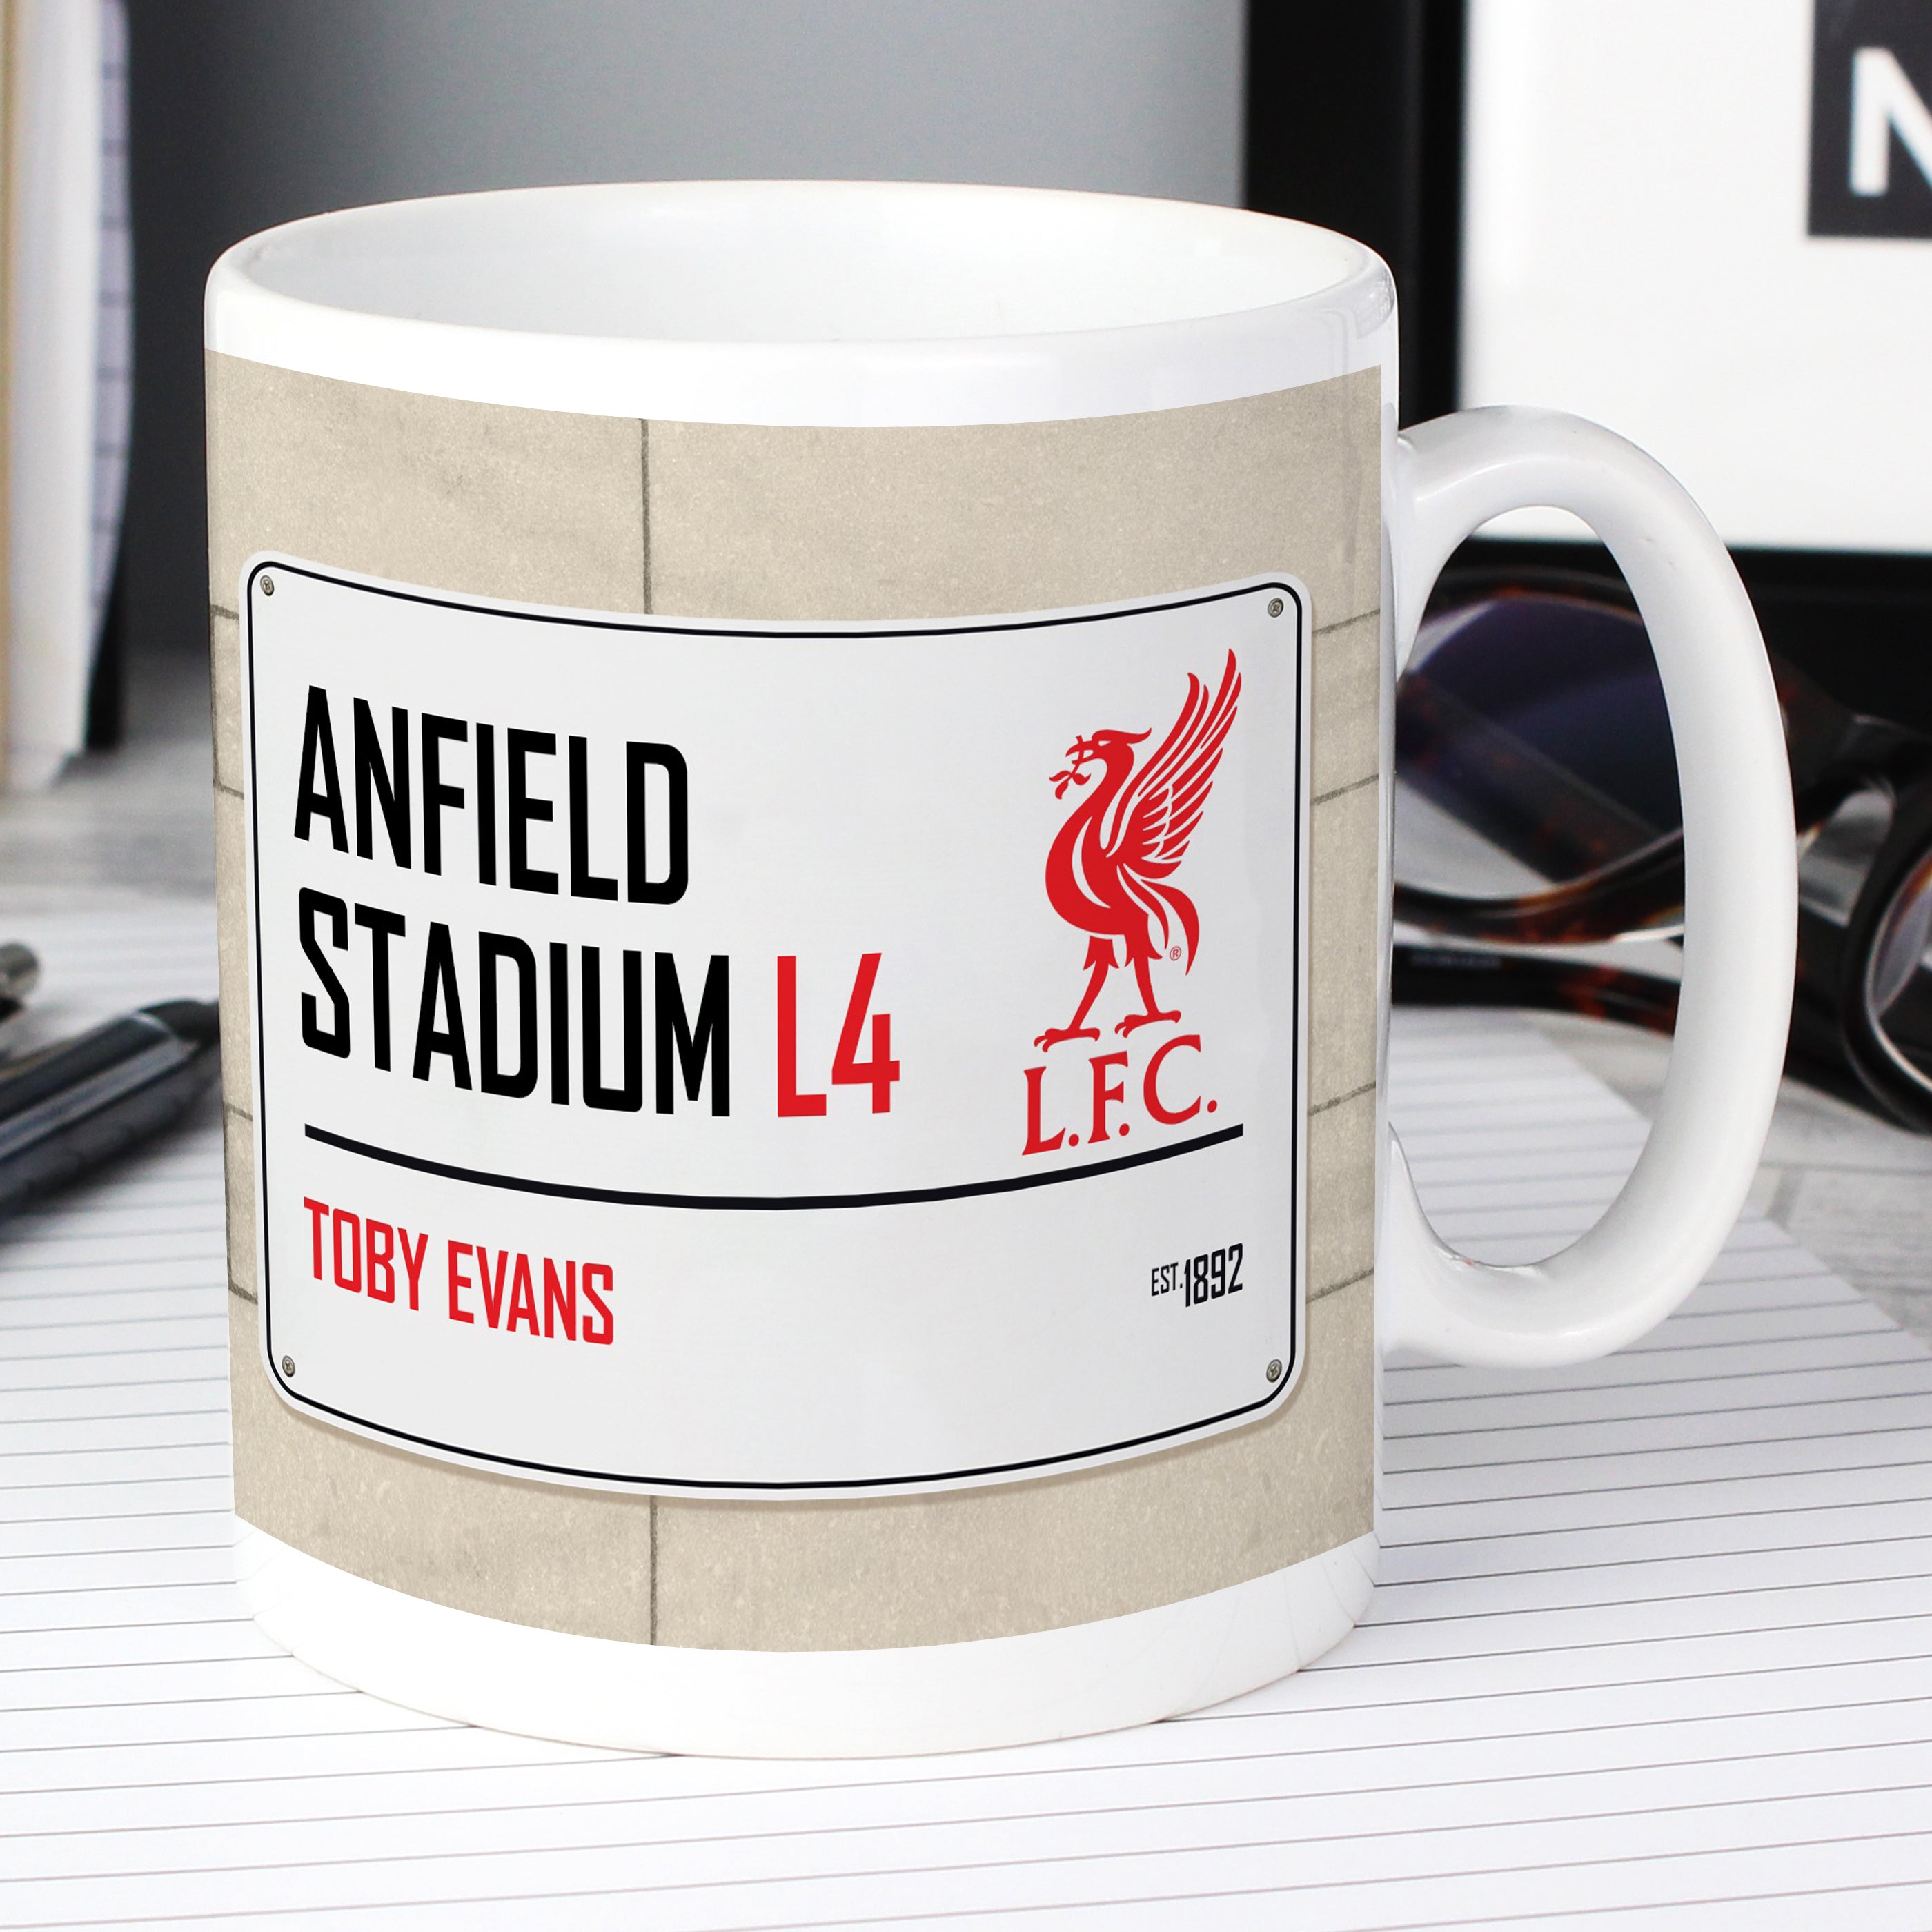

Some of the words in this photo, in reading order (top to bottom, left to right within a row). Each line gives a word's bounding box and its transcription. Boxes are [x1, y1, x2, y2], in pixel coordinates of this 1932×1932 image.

[295, 685, 689, 905] ANFIELD
[299, 887, 730, 1117] STADIUM
[777, 953, 900, 1118] L4
[1022, 1034, 1217, 1156] L.F.C.
[304, 1196, 428, 1312] TOBY
[448, 1240, 613, 1346] EVANS
